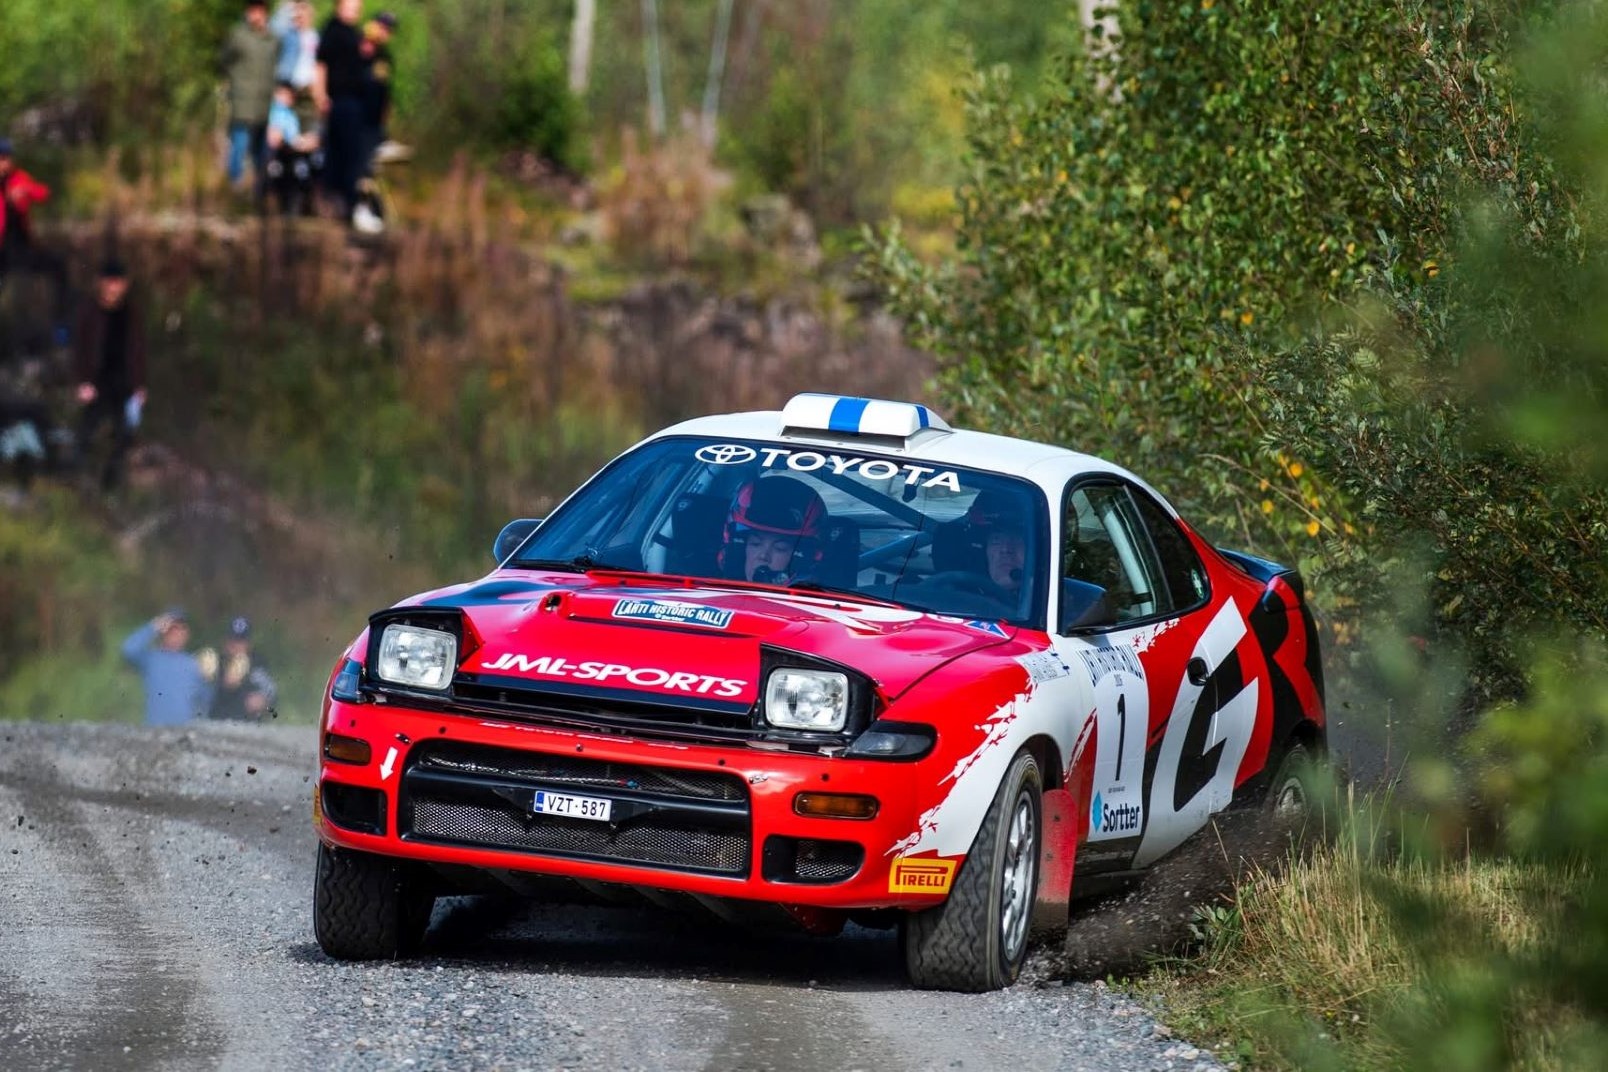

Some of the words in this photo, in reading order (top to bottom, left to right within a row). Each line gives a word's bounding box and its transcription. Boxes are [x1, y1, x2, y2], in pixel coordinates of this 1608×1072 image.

[759, 447, 961, 493] TOYOTA
[618, 600, 648, 615] LAHTI
[649, 603, 695, 618] HISTORIC
[695, 609, 730, 625] RALLY
[481, 653, 748, 697] JML-SPORTS
[1117, 693, 1126, 781] 1
[1102, 803, 1140, 833] Sortter
[895, 865, 949, 887] PIRELLI
